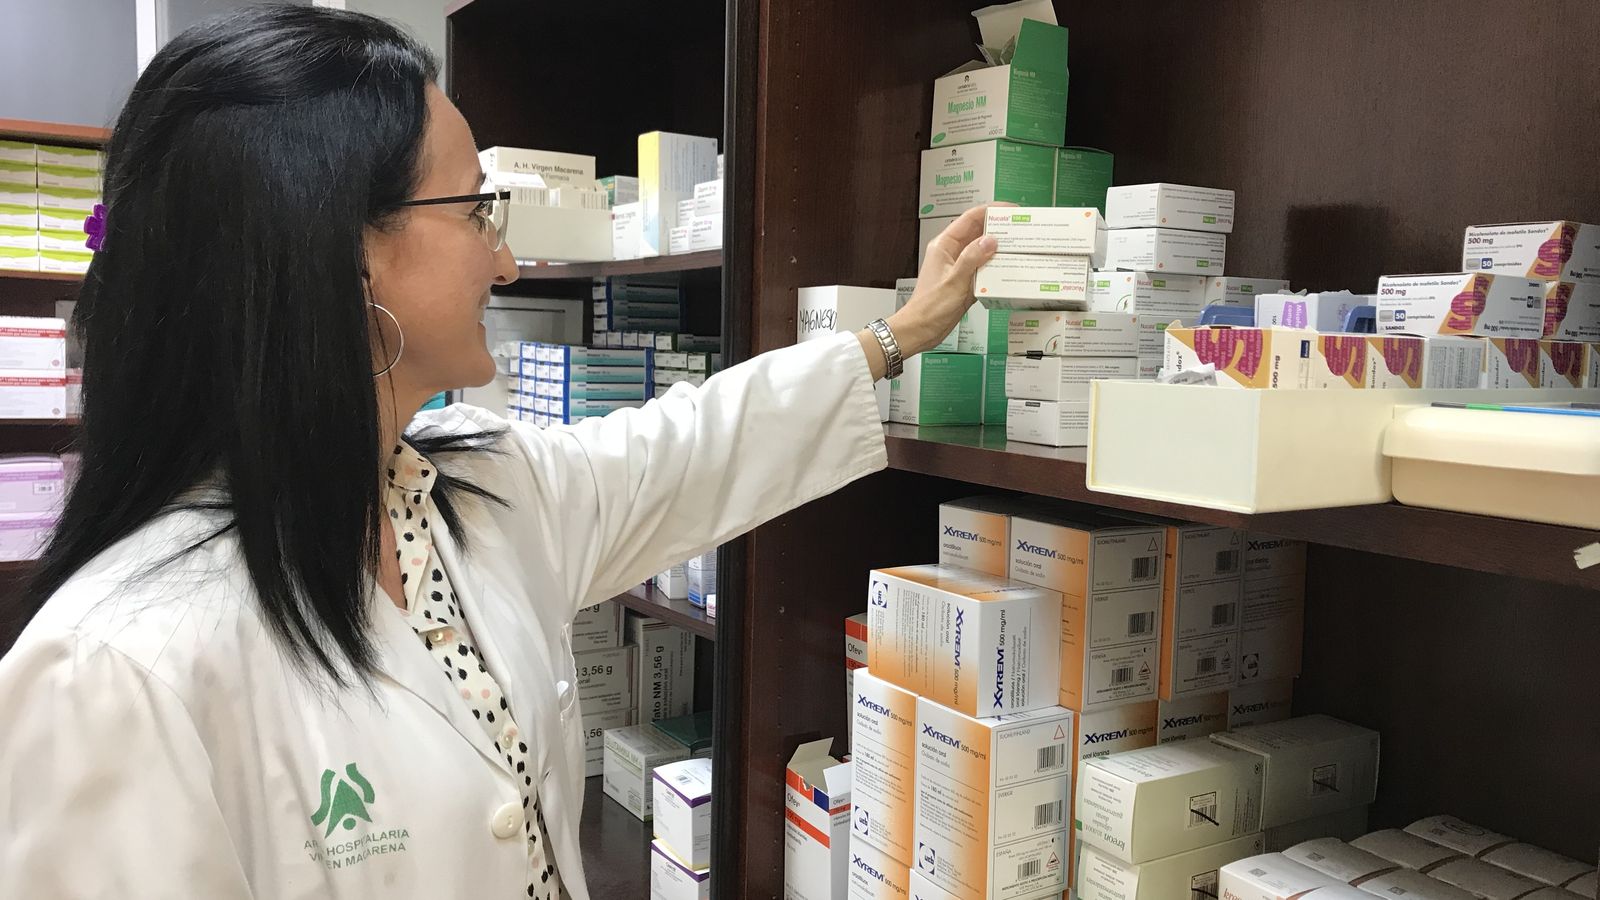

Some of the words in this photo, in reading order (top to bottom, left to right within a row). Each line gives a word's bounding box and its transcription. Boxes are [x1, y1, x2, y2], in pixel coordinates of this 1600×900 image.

[948, 99, 974, 115] Magnesio
[976, 96, 987, 108] NM
[532, 164, 552, 172] Virgen
[554, 166, 584, 175] Macarena
[936, 173, 962, 188] Magnesio
[963, 170, 974, 184] NM
[1482, 260, 1492, 268] 50
[1395, 288, 1406, 296] mg
[1274, 354, 1280, 370] mg
[944, 526, 978, 542] XYREM
[987, 538, 1002, 546] mg/ml
[1016, 540, 1056, 558] XYREM
[1057, 552, 1066, 560] 500
[1066, 556, 1084, 564] mg/ml
[1248, 540, 1282, 550] XYREM
[954, 606, 964, 668] XYREM
[848, 643, 862, 655] Ofev
[582, 664, 604, 677] 3,56
[606, 665, 612, 675] g
[654, 656, 664, 678] 3,56
[994, 648, 1004, 709] XYREM
[653, 682, 661, 698] NM
[858, 694, 889, 717] XYREM
[898, 715, 912, 726] mg/ml
[1233, 702, 1268, 716] XYREM
[1163, 714, 1204, 730] XYREM
[922, 723, 960, 748] XYREM
[960, 744, 969, 754] 500
[970, 748, 986, 760] mg/ml
[1084, 729, 1128, 745] XYREM
[1128, 728, 1137, 736] 500
[787, 792, 800, 808] Ofev
[1104, 832, 1126, 851] kreon
[924, 854, 934, 865] ucb
[853, 854, 884, 882] XYREM
